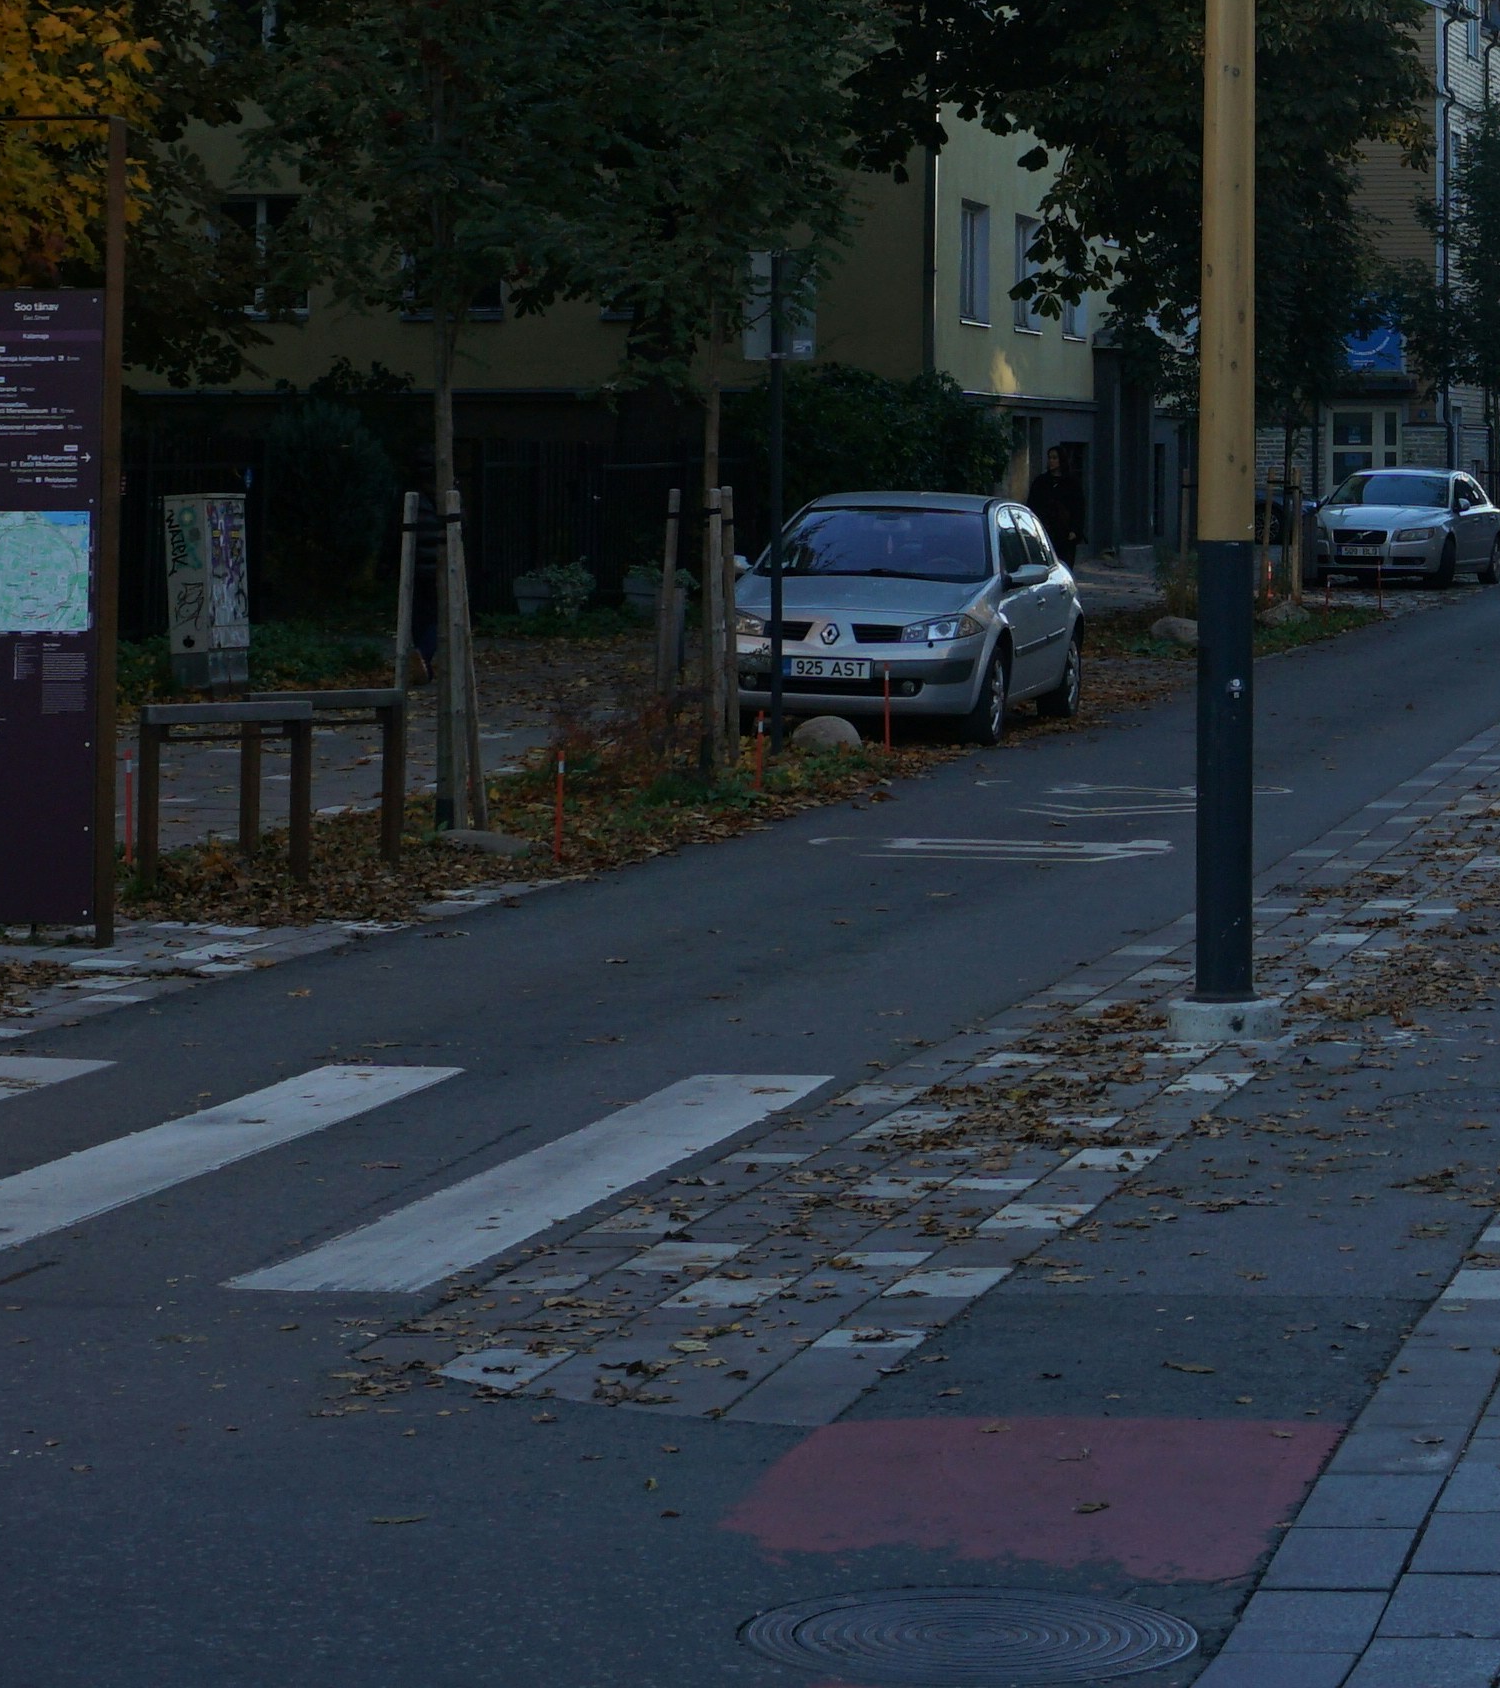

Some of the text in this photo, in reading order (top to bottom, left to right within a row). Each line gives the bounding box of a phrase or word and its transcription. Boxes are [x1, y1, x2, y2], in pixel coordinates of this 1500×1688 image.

[13, 301, 33, 312] Soo
[796, 660, 865, 677] 925 AST
